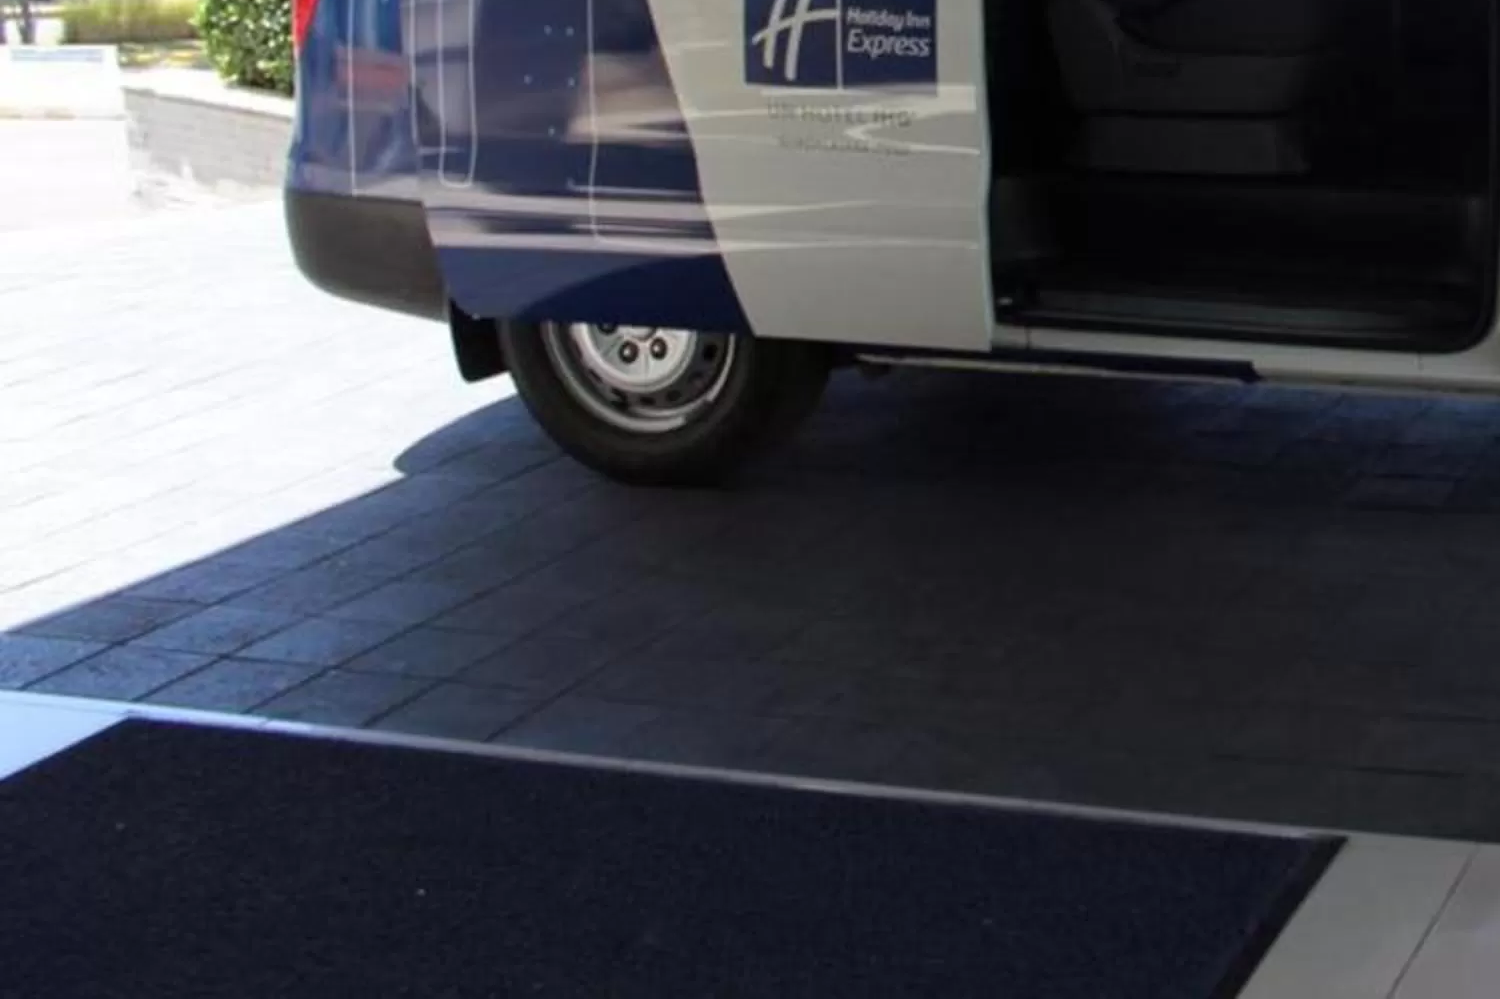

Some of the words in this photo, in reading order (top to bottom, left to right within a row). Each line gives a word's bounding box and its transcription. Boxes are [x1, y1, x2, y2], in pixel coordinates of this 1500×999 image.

[847, 6, 904, 32] Holiday
[906, 10, 931, 30] Inn
[847, 28, 931, 59] Express
